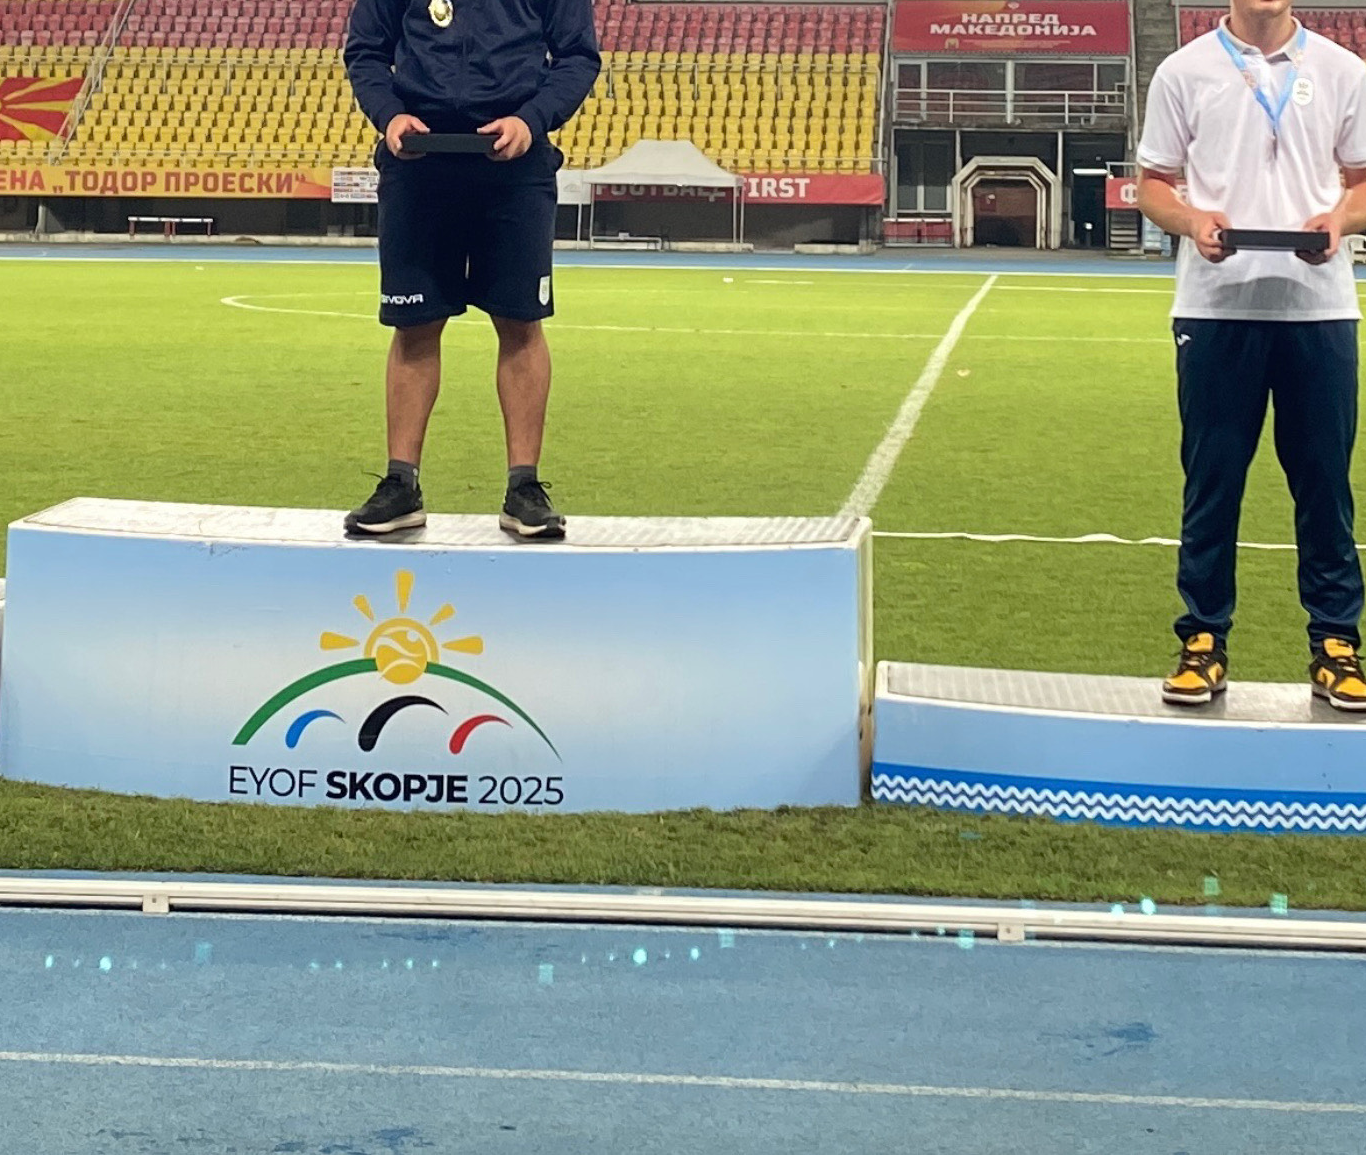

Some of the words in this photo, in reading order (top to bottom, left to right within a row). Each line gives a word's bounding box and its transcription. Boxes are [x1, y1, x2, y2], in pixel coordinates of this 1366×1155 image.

[961, 13, 1060, 25] НАПРЕД
[930, 23, 1097, 37] МАКЕДОНИЈА
[229, 765, 318, 797] EYOF
[325, 770, 468, 803] SKOPJE
[478, 776, 564, 805] 2025
